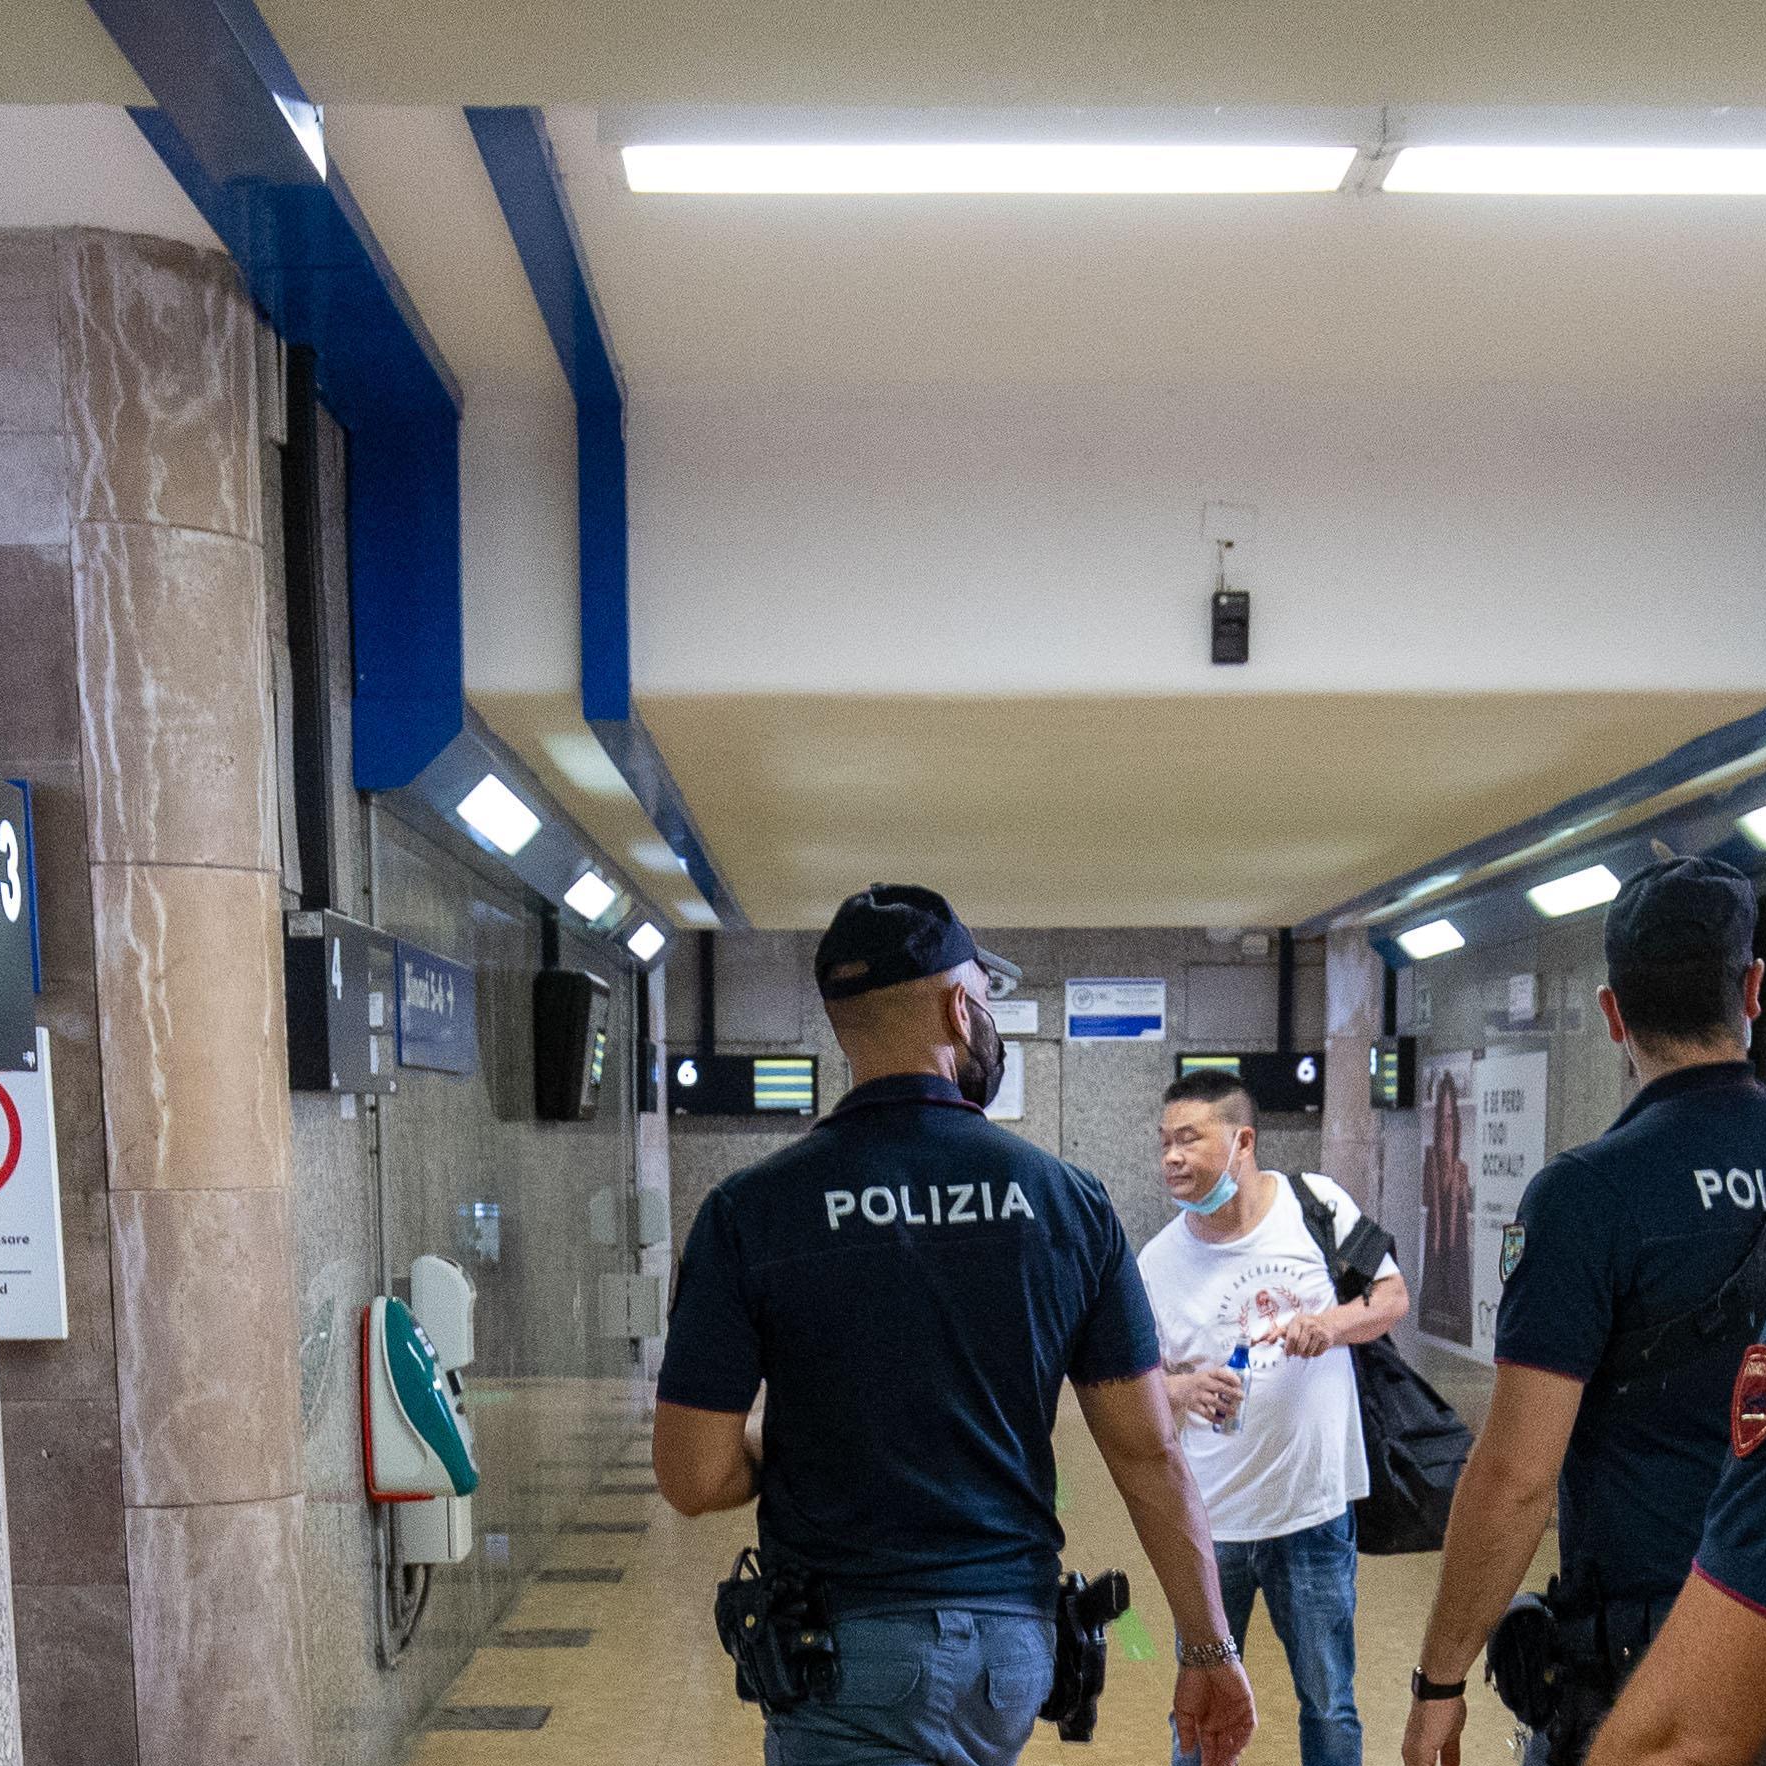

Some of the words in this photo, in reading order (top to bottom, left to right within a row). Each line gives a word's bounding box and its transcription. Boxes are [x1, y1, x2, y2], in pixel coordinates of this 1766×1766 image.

[332, 937, 343, 999] 4
[677, 1059, 698, 1087] 6
[1297, 1057, 1316, 1083] 6
[825, 1180, 1034, 1231] POLIZIA
